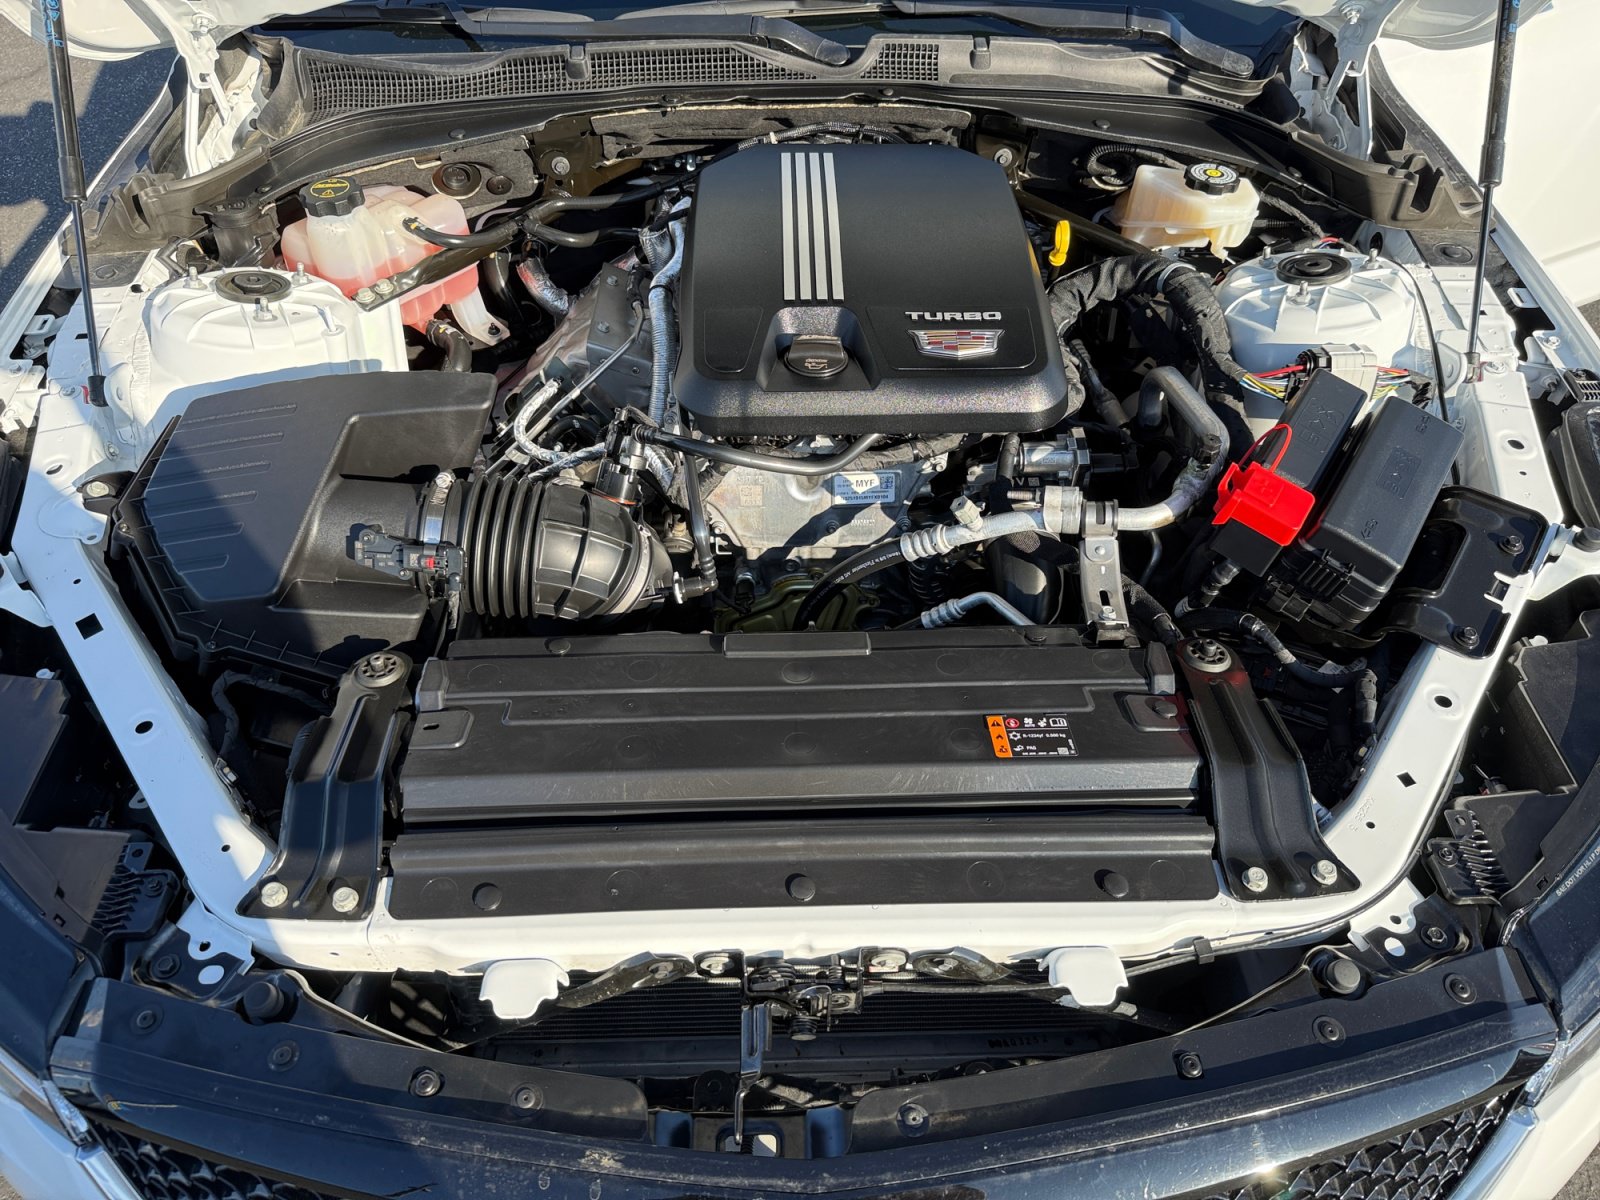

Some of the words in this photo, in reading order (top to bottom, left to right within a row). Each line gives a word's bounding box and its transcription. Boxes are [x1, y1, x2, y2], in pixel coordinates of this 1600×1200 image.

[905, 311, 1002, 321] TURBO
[856, 480, 875, 488] MYF
[1556, 884, 1568, 896] SAE
[1565, 875, 1576, 888] DOT
[1574, 866, 1586, 878] VOR
